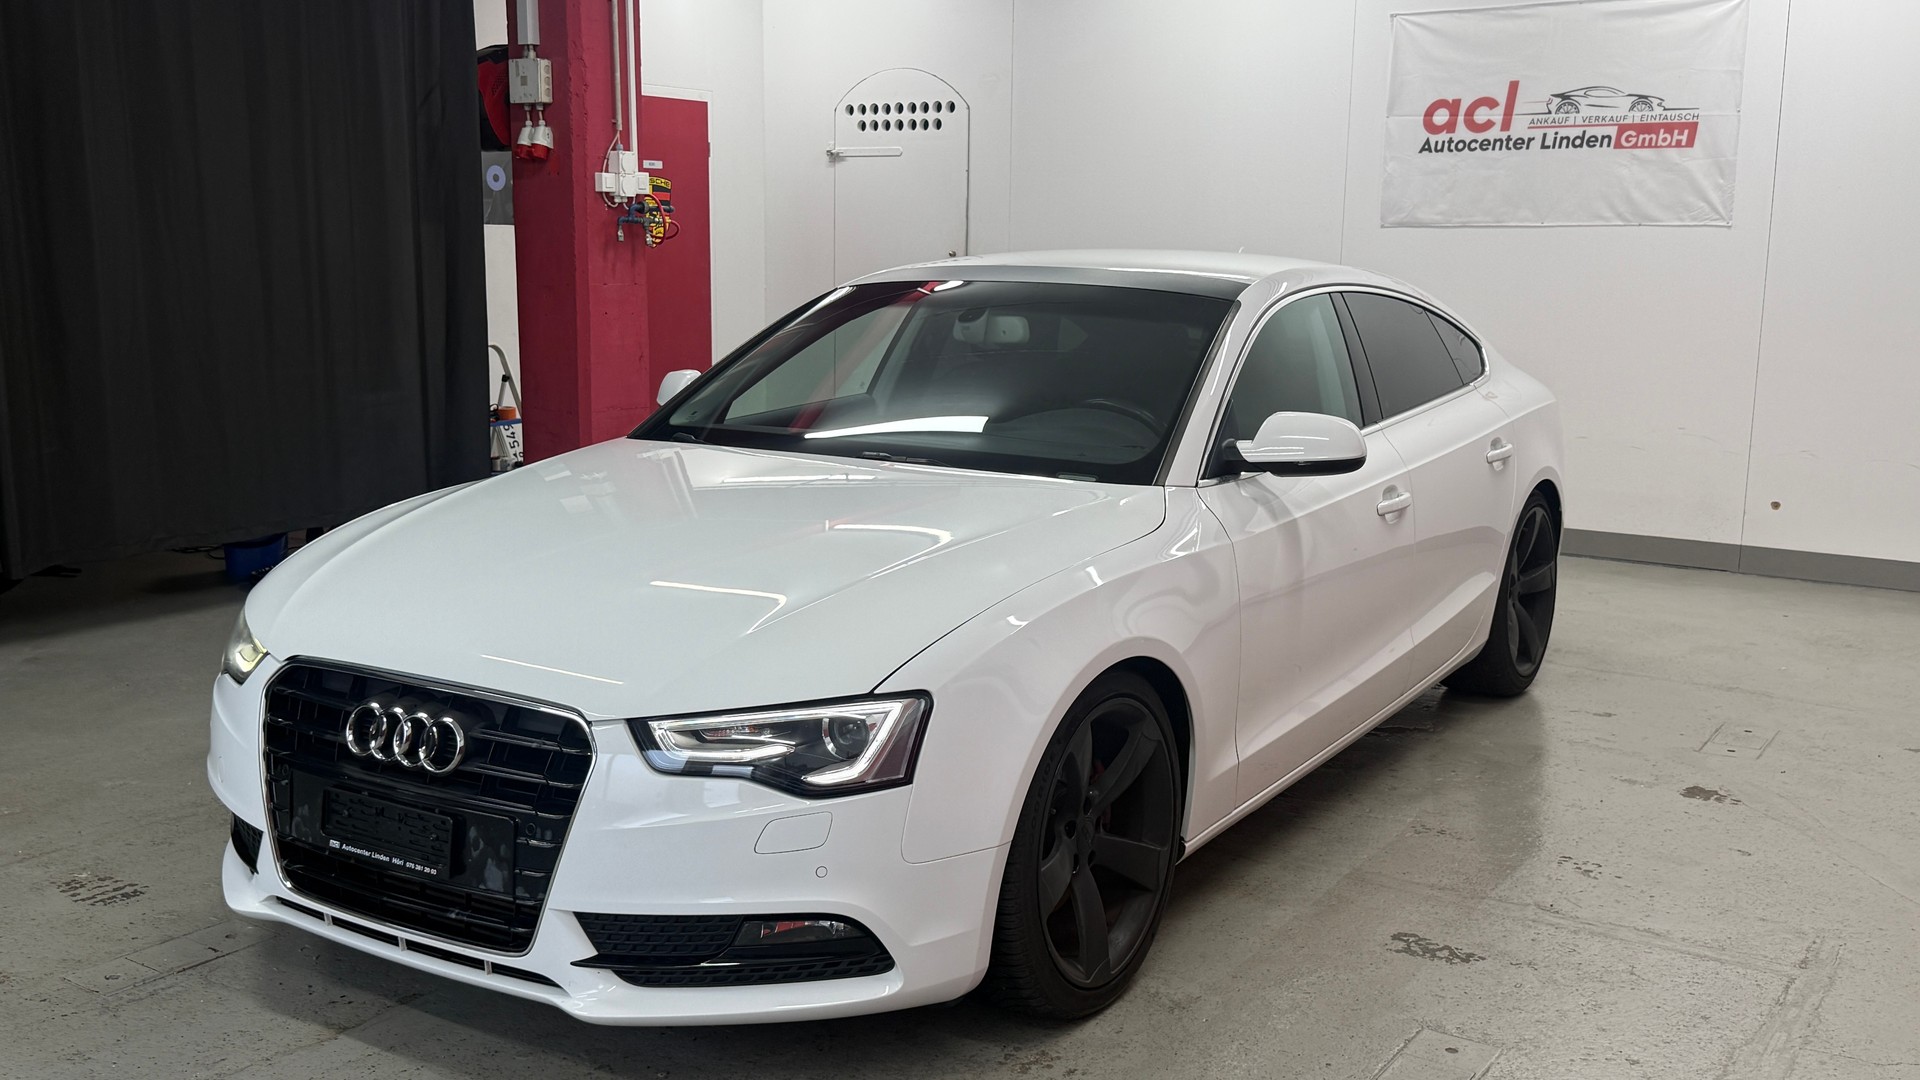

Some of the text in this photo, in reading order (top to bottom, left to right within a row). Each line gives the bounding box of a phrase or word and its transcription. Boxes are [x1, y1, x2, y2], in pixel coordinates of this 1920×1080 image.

[1422, 80, 1520, 135] acl
[1528, 112, 1700, 126] ANKAUF VERKAUF EINTAUSCH
[1418, 129, 1688, 154] Autocenter Linden GmbH
[342, 844, 371, 856] Autocenter
[371, 851, 390, 861] Linden
